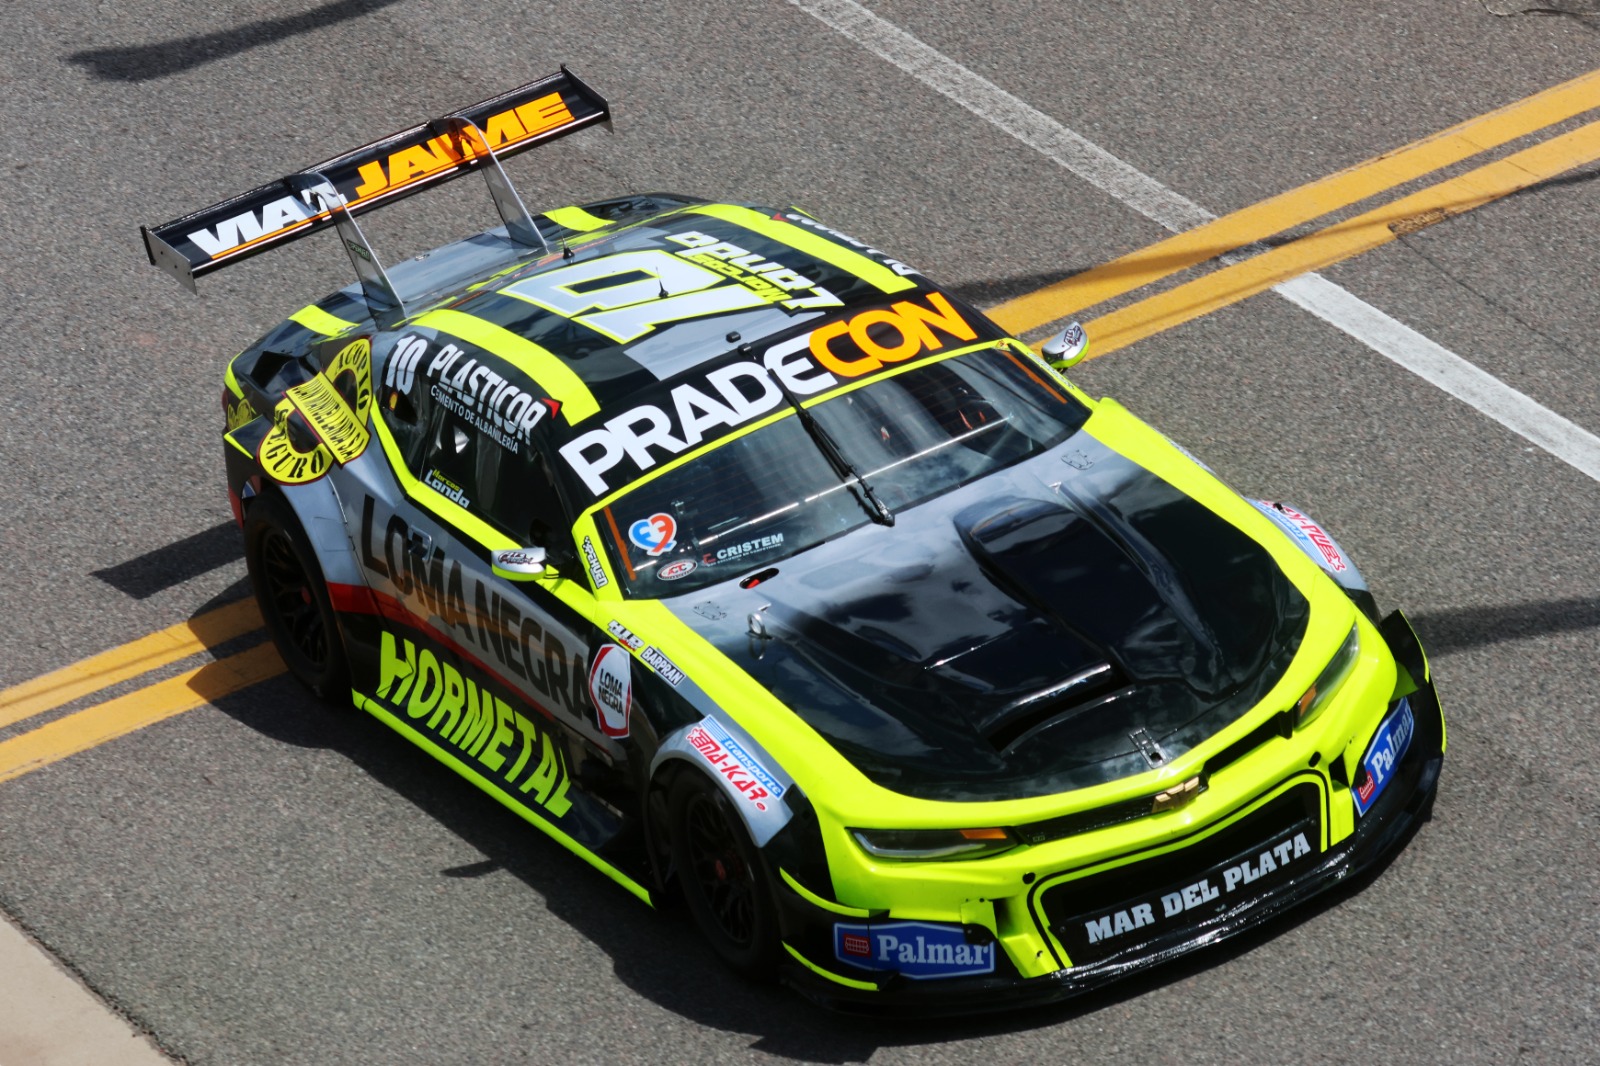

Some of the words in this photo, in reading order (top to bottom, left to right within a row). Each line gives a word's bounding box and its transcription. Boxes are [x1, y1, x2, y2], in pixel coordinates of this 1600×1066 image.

[355, 92, 575, 197] JAIME
[335, 343, 369, 410] ACOPIO
[386, 335, 428, 394] 10
[427, 343, 547, 445] PLASTICOR
[558, 292, 978, 496] PRADECON
[266, 409, 324, 478] SEGURO
[430, 384, 464, 417] CEMENTO
[464, 408, 475, 422] DE
[475, 416, 519, 454] ALBAÑILERÍA
[424, 469, 470, 509] Landa
[716, 533, 784, 560] CRISTEM
[361, 494, 475, 642] LOMA
[475, 578, 602, 733] NEGRA
[600, 668, 622, 697] LOMA
[642, 648, 683, 684] BARPRAN
[376, 631, 572, 818] HORMETAL
[599, 689, 624, 718] NEGRA
[724, 740, 782, 796] transporte
[1371, 705, 1412, 784] Palmar
[1085, 902, 1155, 944] MAR
[1160, 879, 1219, 918] DEL
[1223, 832, 1311, 892] PLATA
[877, 935, 988, 965] Palmar
